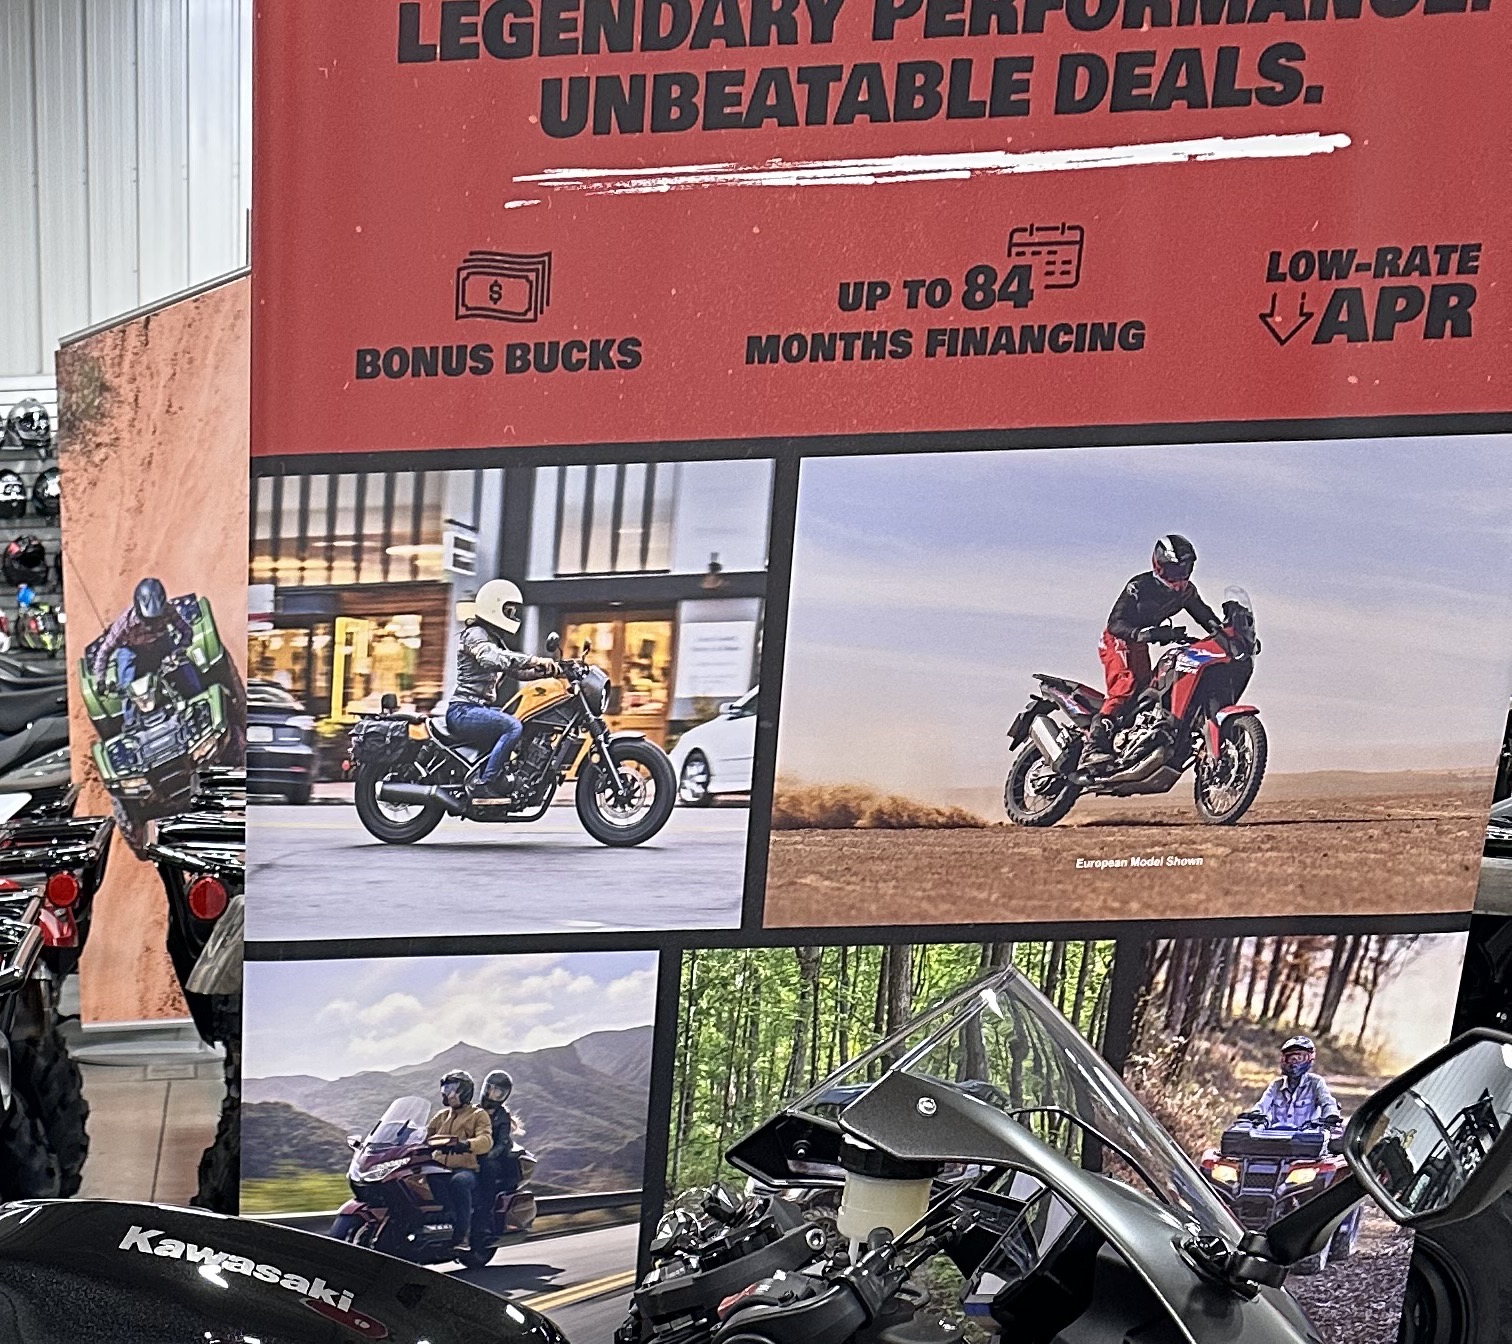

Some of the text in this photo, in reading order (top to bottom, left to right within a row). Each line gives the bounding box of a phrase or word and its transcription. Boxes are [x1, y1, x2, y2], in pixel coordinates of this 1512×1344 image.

[398, 0, 846, 64] LEGENDARY
[540, 41, 1324, 139] UNBEATABLE DEALS.
[1266, 242, 1482, 283] LOW-RATE
[838, 263, 1035, 313] UP TO 84
[1311, 282, 1478, 345] APR
[355, 336, 643, 380] BONUS BUCKS
[745, 320, 1147, 365] MONTHS FINANCING
[1075, 854, 1204, 870] European Model Shown
[118, 1225, 355, 1313] Kawasaki
